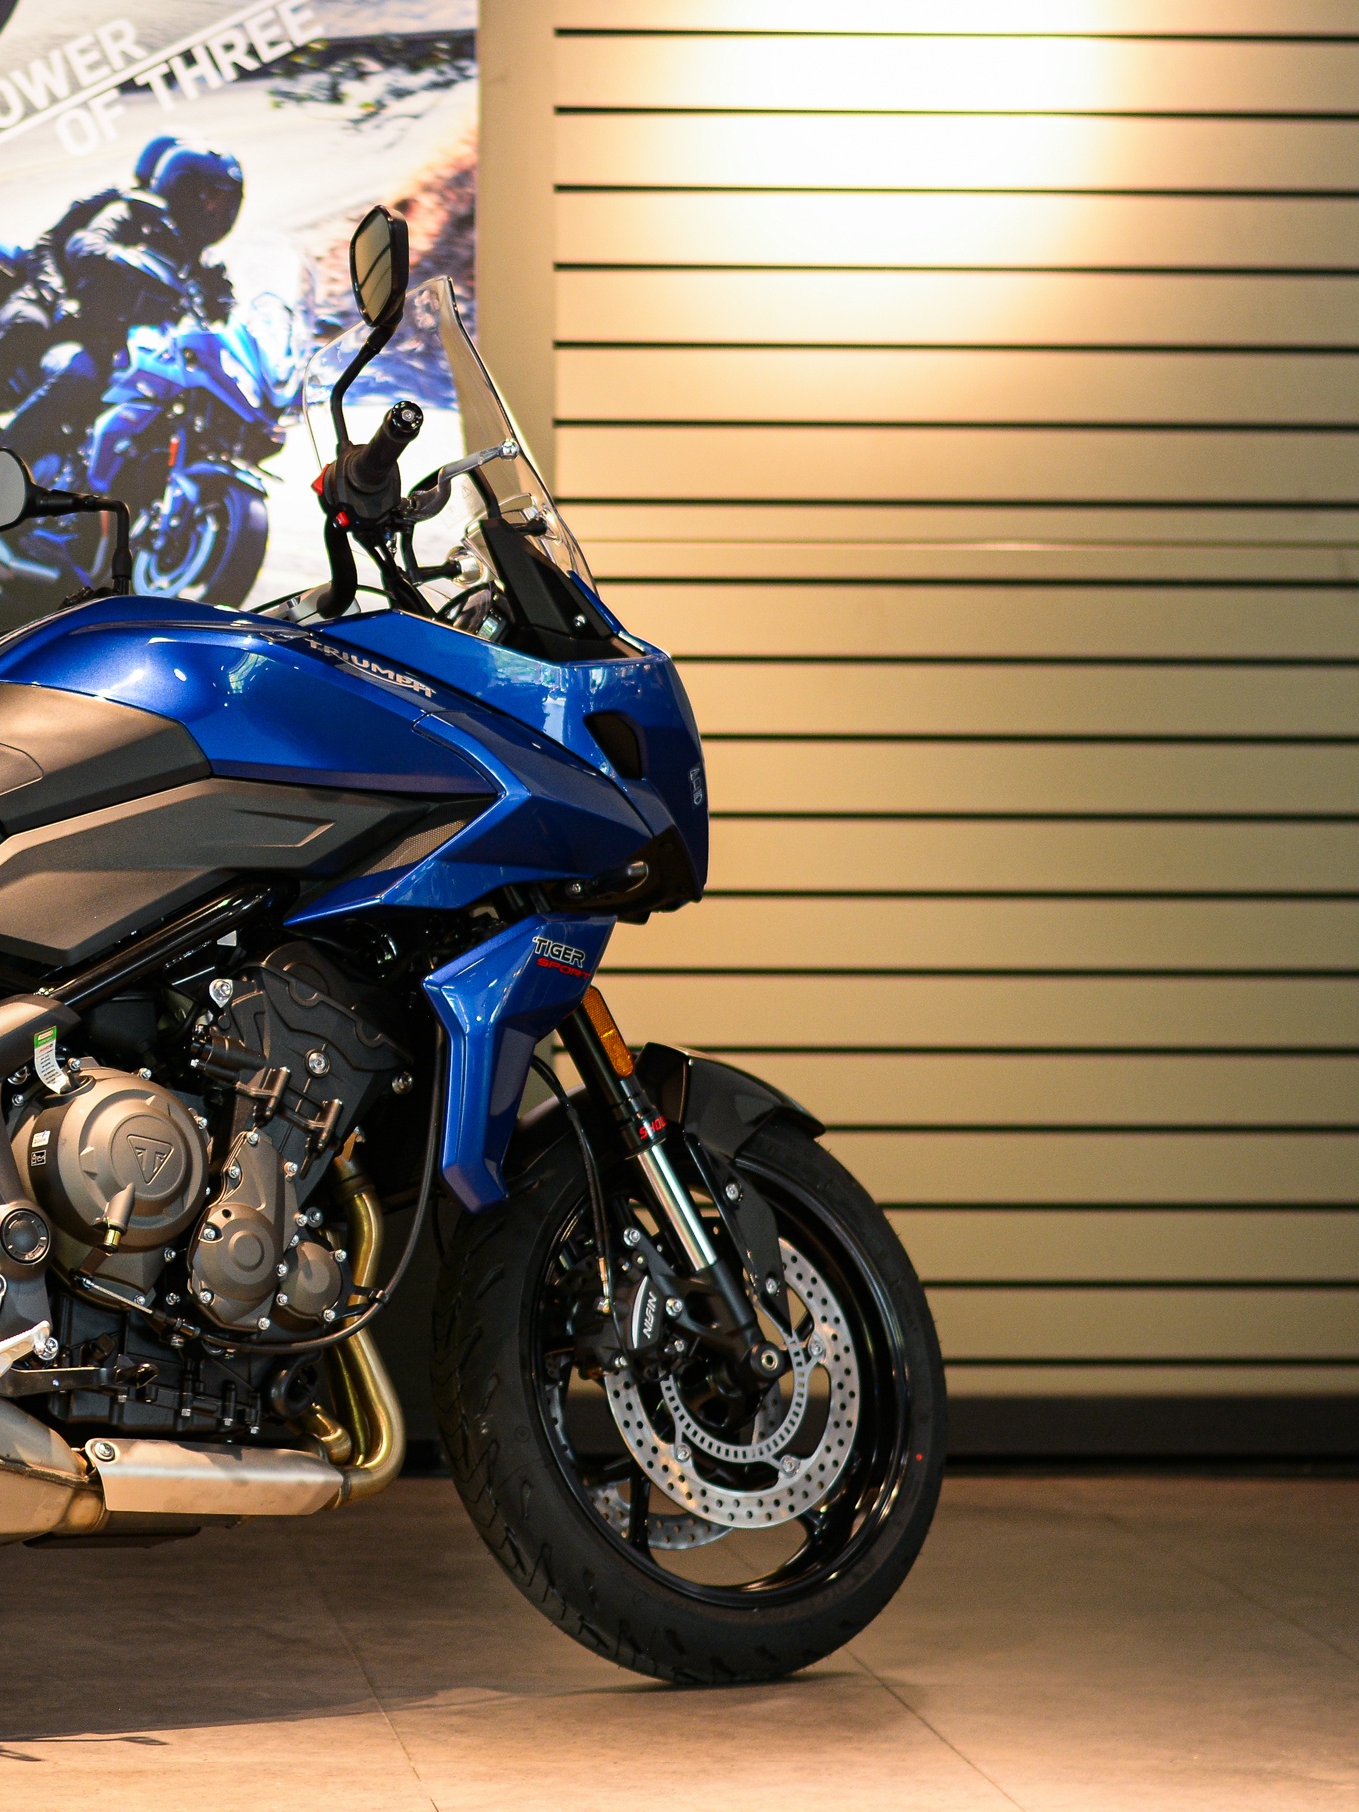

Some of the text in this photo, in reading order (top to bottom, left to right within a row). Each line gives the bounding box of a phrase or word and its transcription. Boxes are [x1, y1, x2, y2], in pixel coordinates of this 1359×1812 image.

[55, 0, 325, 156] OF THREE
[304, 638, 436, 698] TRIUMPH
[532, 936, 585, 968] TIGER
[537, 957, 591, 980] SPORT
